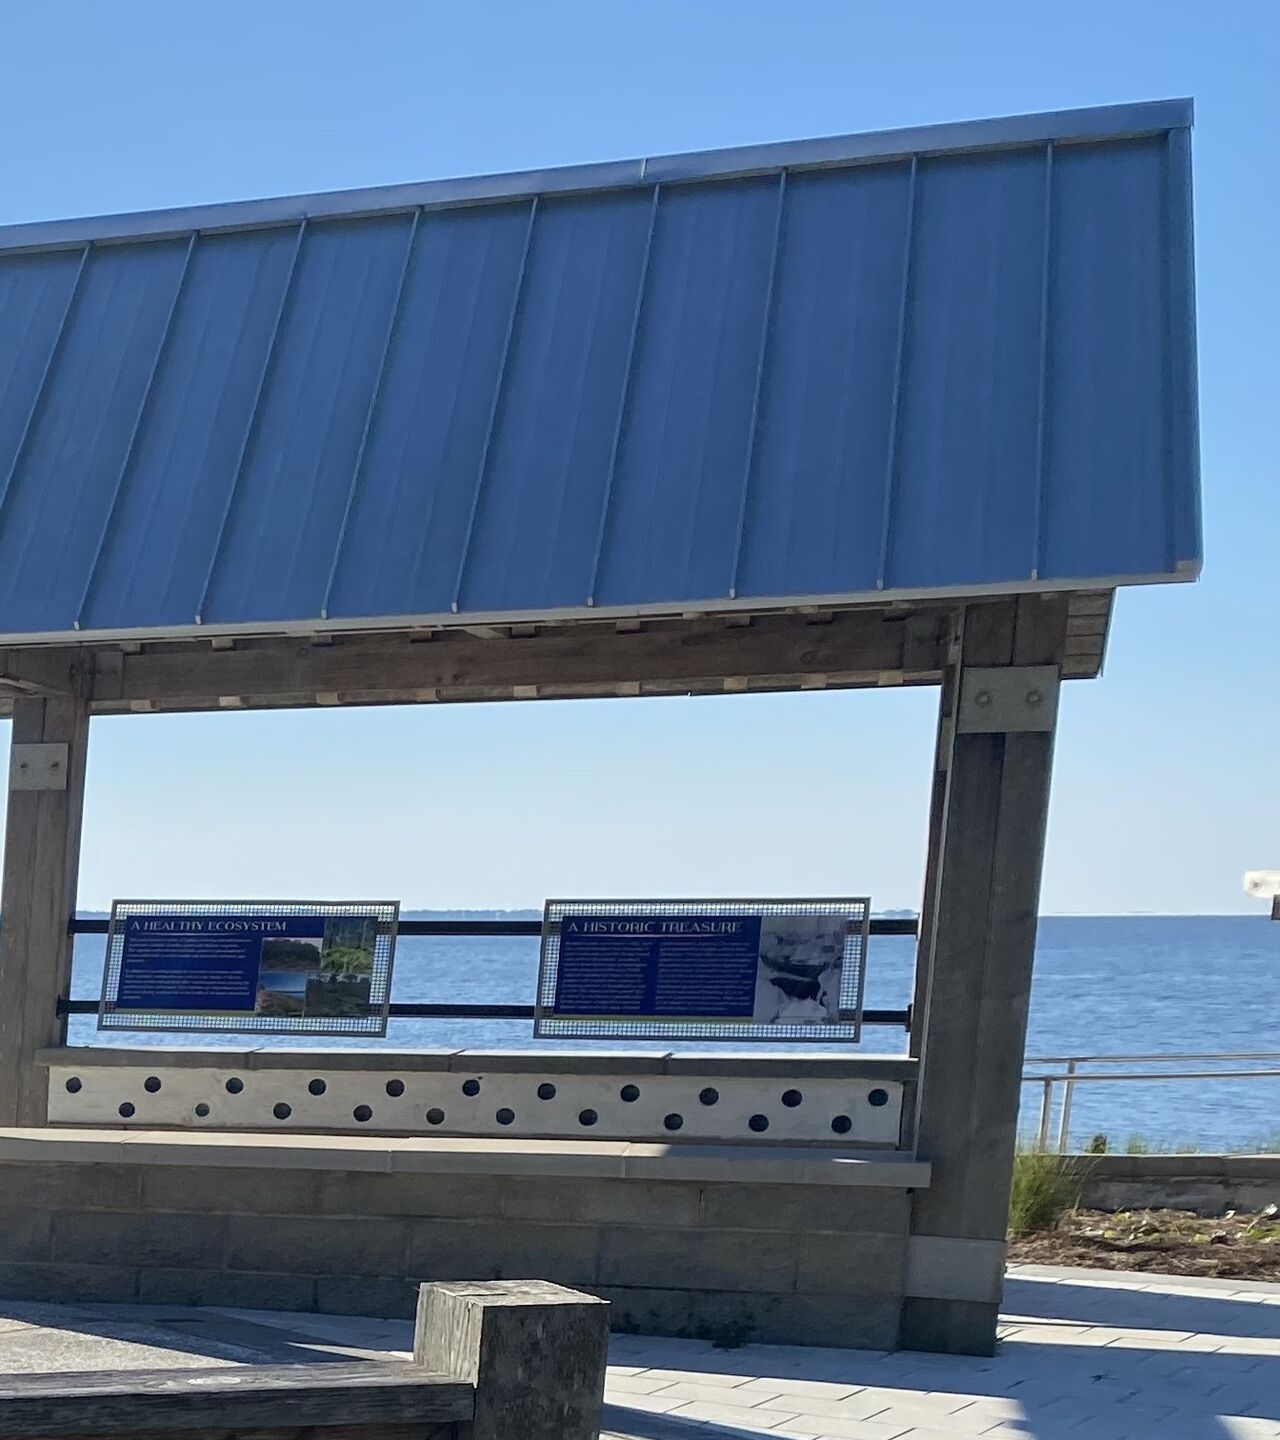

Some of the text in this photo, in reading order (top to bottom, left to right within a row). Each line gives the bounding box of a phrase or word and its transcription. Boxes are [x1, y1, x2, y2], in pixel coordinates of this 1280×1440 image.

[143, 921, 204, 931] HEALTHY
[208, 921, 287, 931] ECOSYSTEM
[583, 921, 655, 933] HISTORIC
[660, 921, 743, 933] TREASURE
